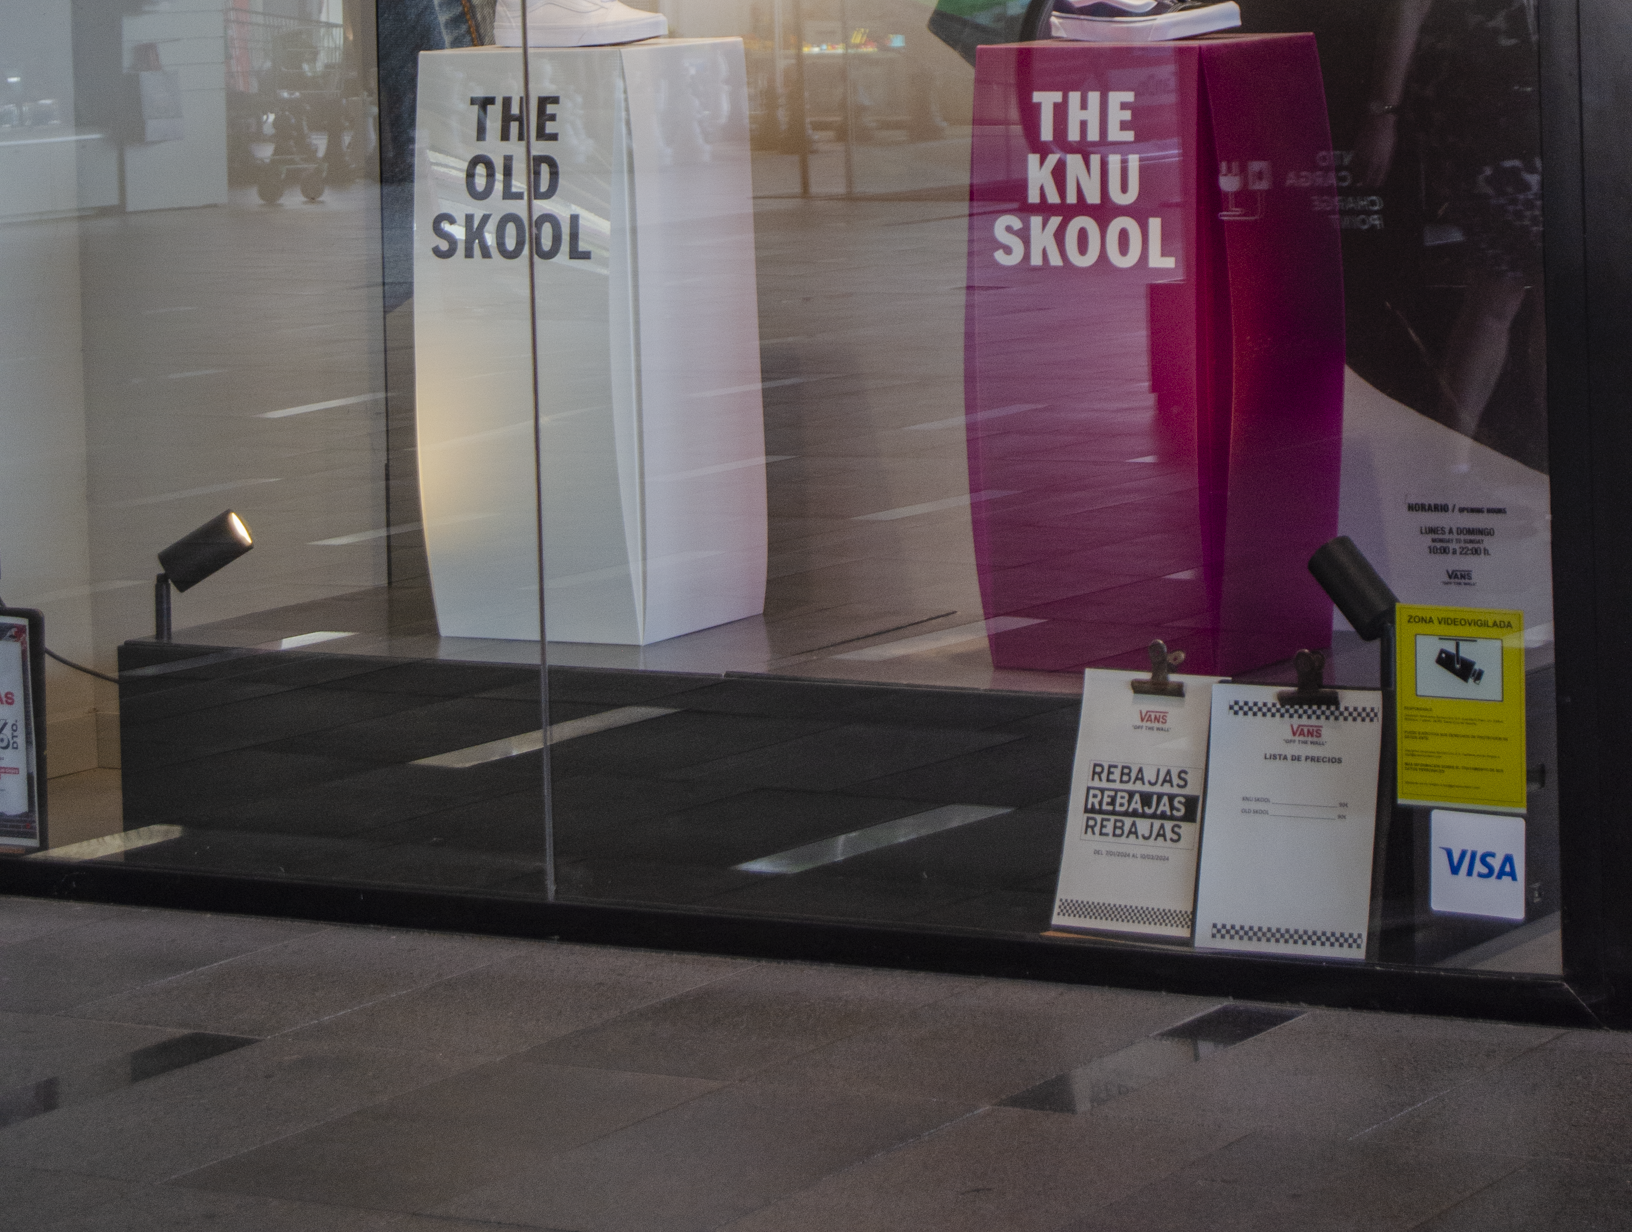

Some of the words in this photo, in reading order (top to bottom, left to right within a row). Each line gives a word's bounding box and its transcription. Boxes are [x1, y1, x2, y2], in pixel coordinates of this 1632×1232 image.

[469, 96, 560, 142] THE
[1032, 91, 1135, 142] THE
[465, 154, 560, 201] OLD
[1027, 153, 1140, 206] KNU
[431, 212, 592, 260] SKOOL
[993, 214, 1176, 268] SKOOL
[1407, 502, 1450, 514] HORARIO
[1420, 526, 1446, 536] LUNES
[1447, 527, 1454, 536] A
[1456, 527, 1495, 537] DOMINGO
[1428, 545, 1450, 555] 10:00
[1451, 547, 1457, 555] a
[1459, 546, 1482, 556] 22:00
[1446, 569, 1473, 580] VANS
[1407, 614, 1434, 625] ZONA
[1437, 616, 1513, 629] VIDEOVIGILADA
[1139, 709, 1169, 724] VANS
[1290, 724, 1323, 738] VANS
[1264, 753, 1289, 761] LISTA
[1291, 754, 1302, 762] DE
[1304, 755, 1343, 764] PRECIOS
[1091, 762, 1189, 789] REBAJAS
[1087, 788, 1186, 816] REBAJAS
[1084, 815, 1183, 843] REBAJAS
[1439, 846, 1518, 882] VISA
